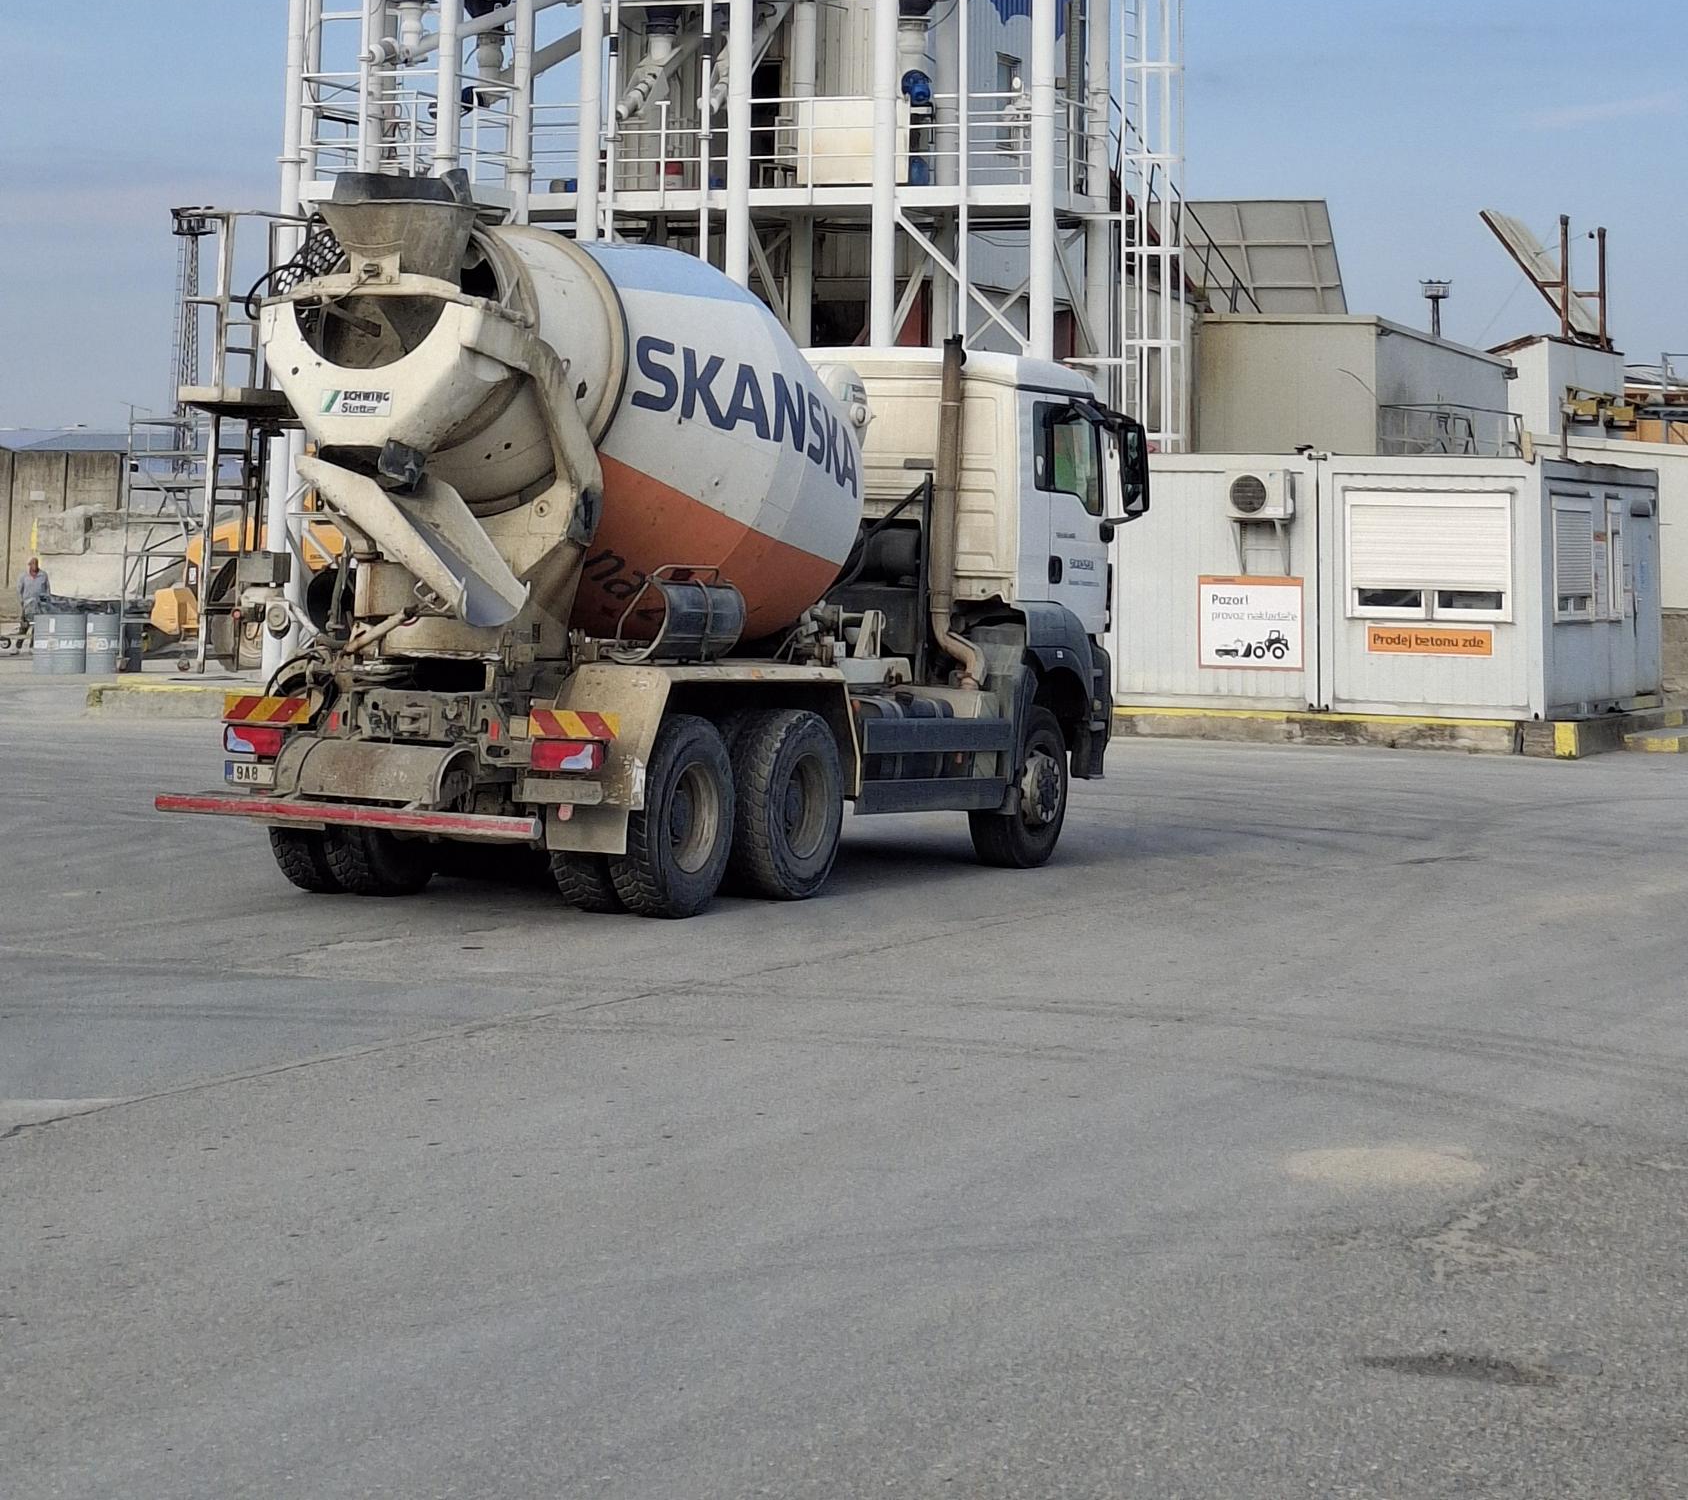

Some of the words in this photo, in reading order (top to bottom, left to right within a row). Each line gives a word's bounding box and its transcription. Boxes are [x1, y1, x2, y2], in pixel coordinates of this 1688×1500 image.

[631, 336, 858, 499] SKANSKA
[1211, 594, 1249, 606] Pozor!
[1211, 611, 1245, 621] provoz
[1373, 633, 1412, 649] Prodej
[1415, 634, 1459, 648] betonu
[1462, 636, 1485, 648] zde
[236, 765, 258, 781] 9A8
